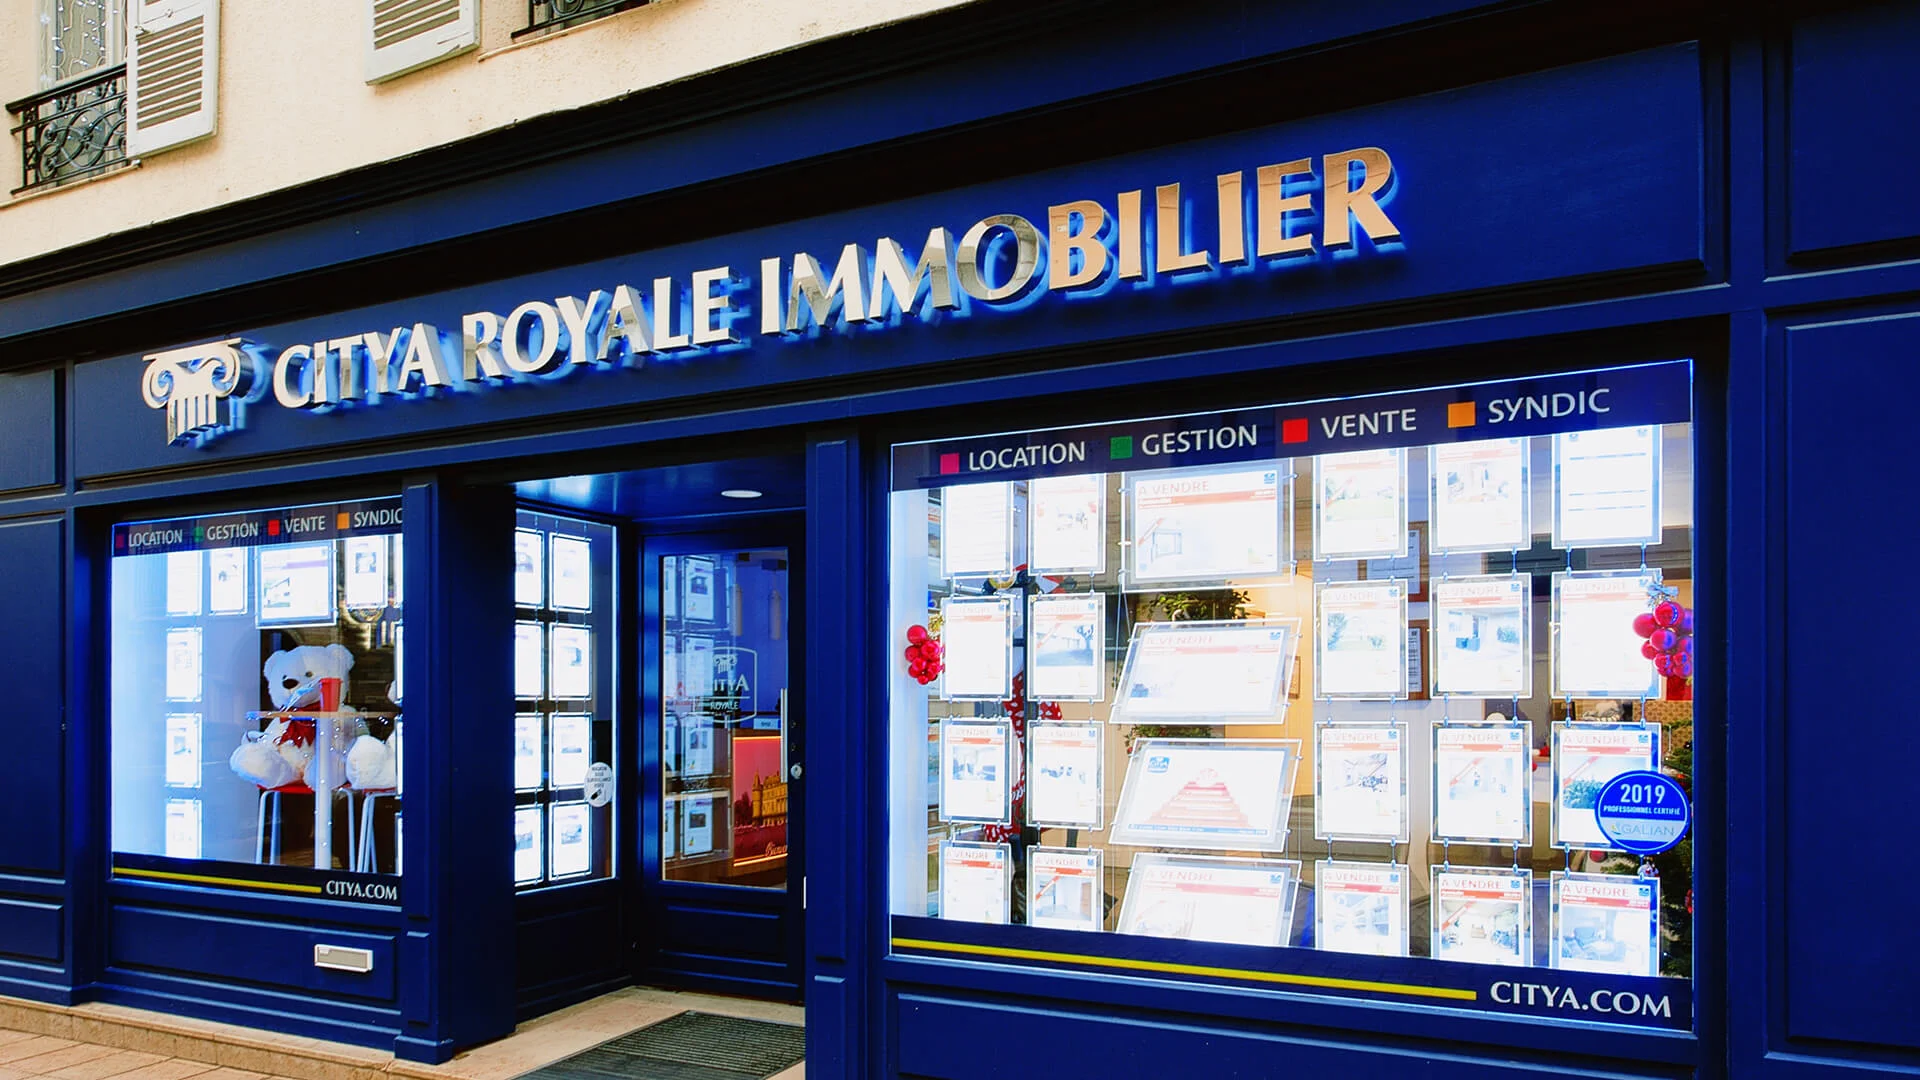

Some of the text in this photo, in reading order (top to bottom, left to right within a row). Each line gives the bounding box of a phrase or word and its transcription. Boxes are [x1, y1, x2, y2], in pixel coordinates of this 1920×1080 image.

[273, 146, 1402, 408] CITYA ROYALE IMMOBILIER
[968, 388, 1611, 472] LOCATION GESTION VENTE SYNDIC
[1152, 481, 1209, 496] VENDRE
[128, 507, 403, 547] LOCATION GESTION VENTE SYNDIC
[1620, 783, 1666, 804] 2019
[325, 879, 399, 901] CITYA.COM
[1575, 885, 1628, 897] VENDRE
[1489, 980, 1672, 1018] CITYA.COM
